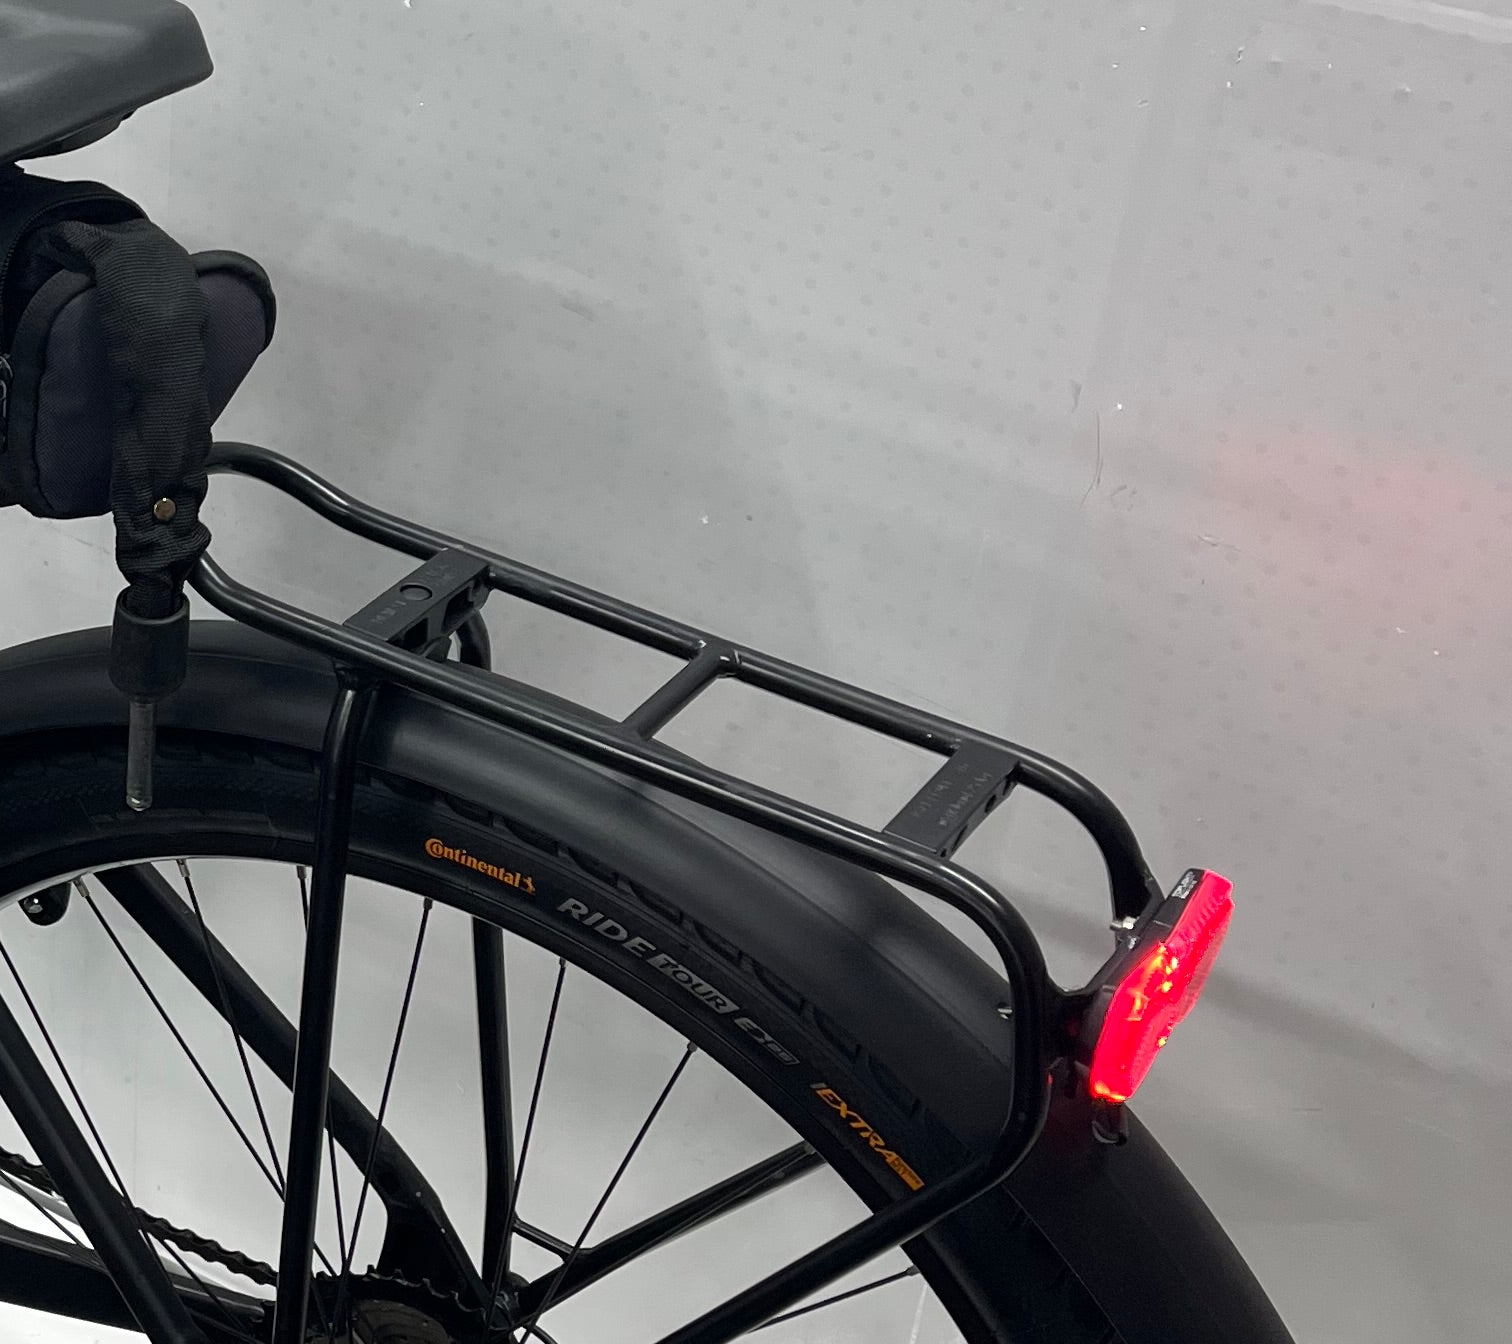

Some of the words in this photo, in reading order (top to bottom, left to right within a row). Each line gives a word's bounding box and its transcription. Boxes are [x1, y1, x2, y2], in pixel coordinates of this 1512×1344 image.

[424, 837, 522, 888] Continental
[555, 896, 657, 957] RIDE
[656, 956, 730, 1011] TOUR
[815, 1088, 900, 1165] EXTRA
